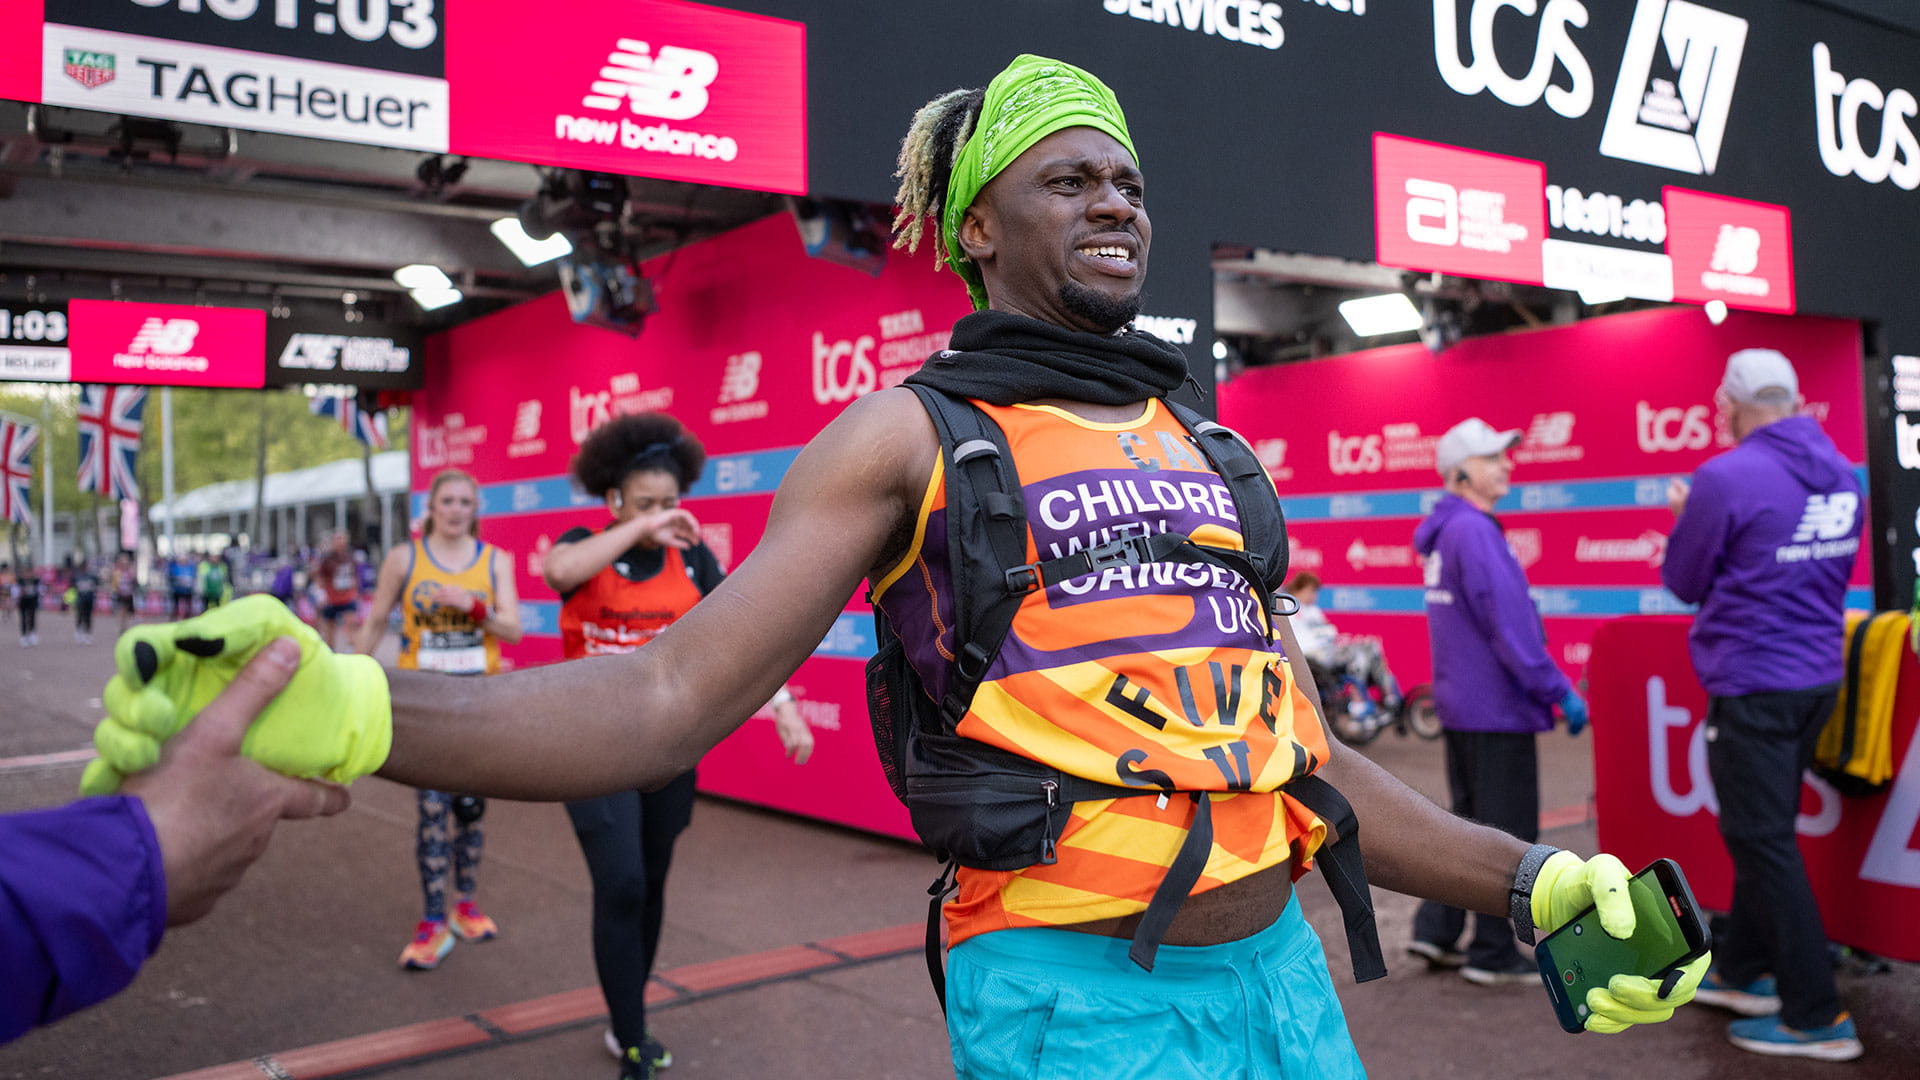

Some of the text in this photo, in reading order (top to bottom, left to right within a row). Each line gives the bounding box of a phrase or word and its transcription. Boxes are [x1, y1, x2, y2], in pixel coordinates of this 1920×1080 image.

[555, 114, 739, 162] new balance
[1812, 42, 1920, 190] tcs
[812, 330, 877, 405] tcs
[1636, 400, 1712, 453] tcs
[1117, 431, 1214, 474] CA
[1328, 430, 1383, 475] tcs
[1039, 479, 1238, 531] CHILDRE
[1207, 595, 1262, 636] UK
